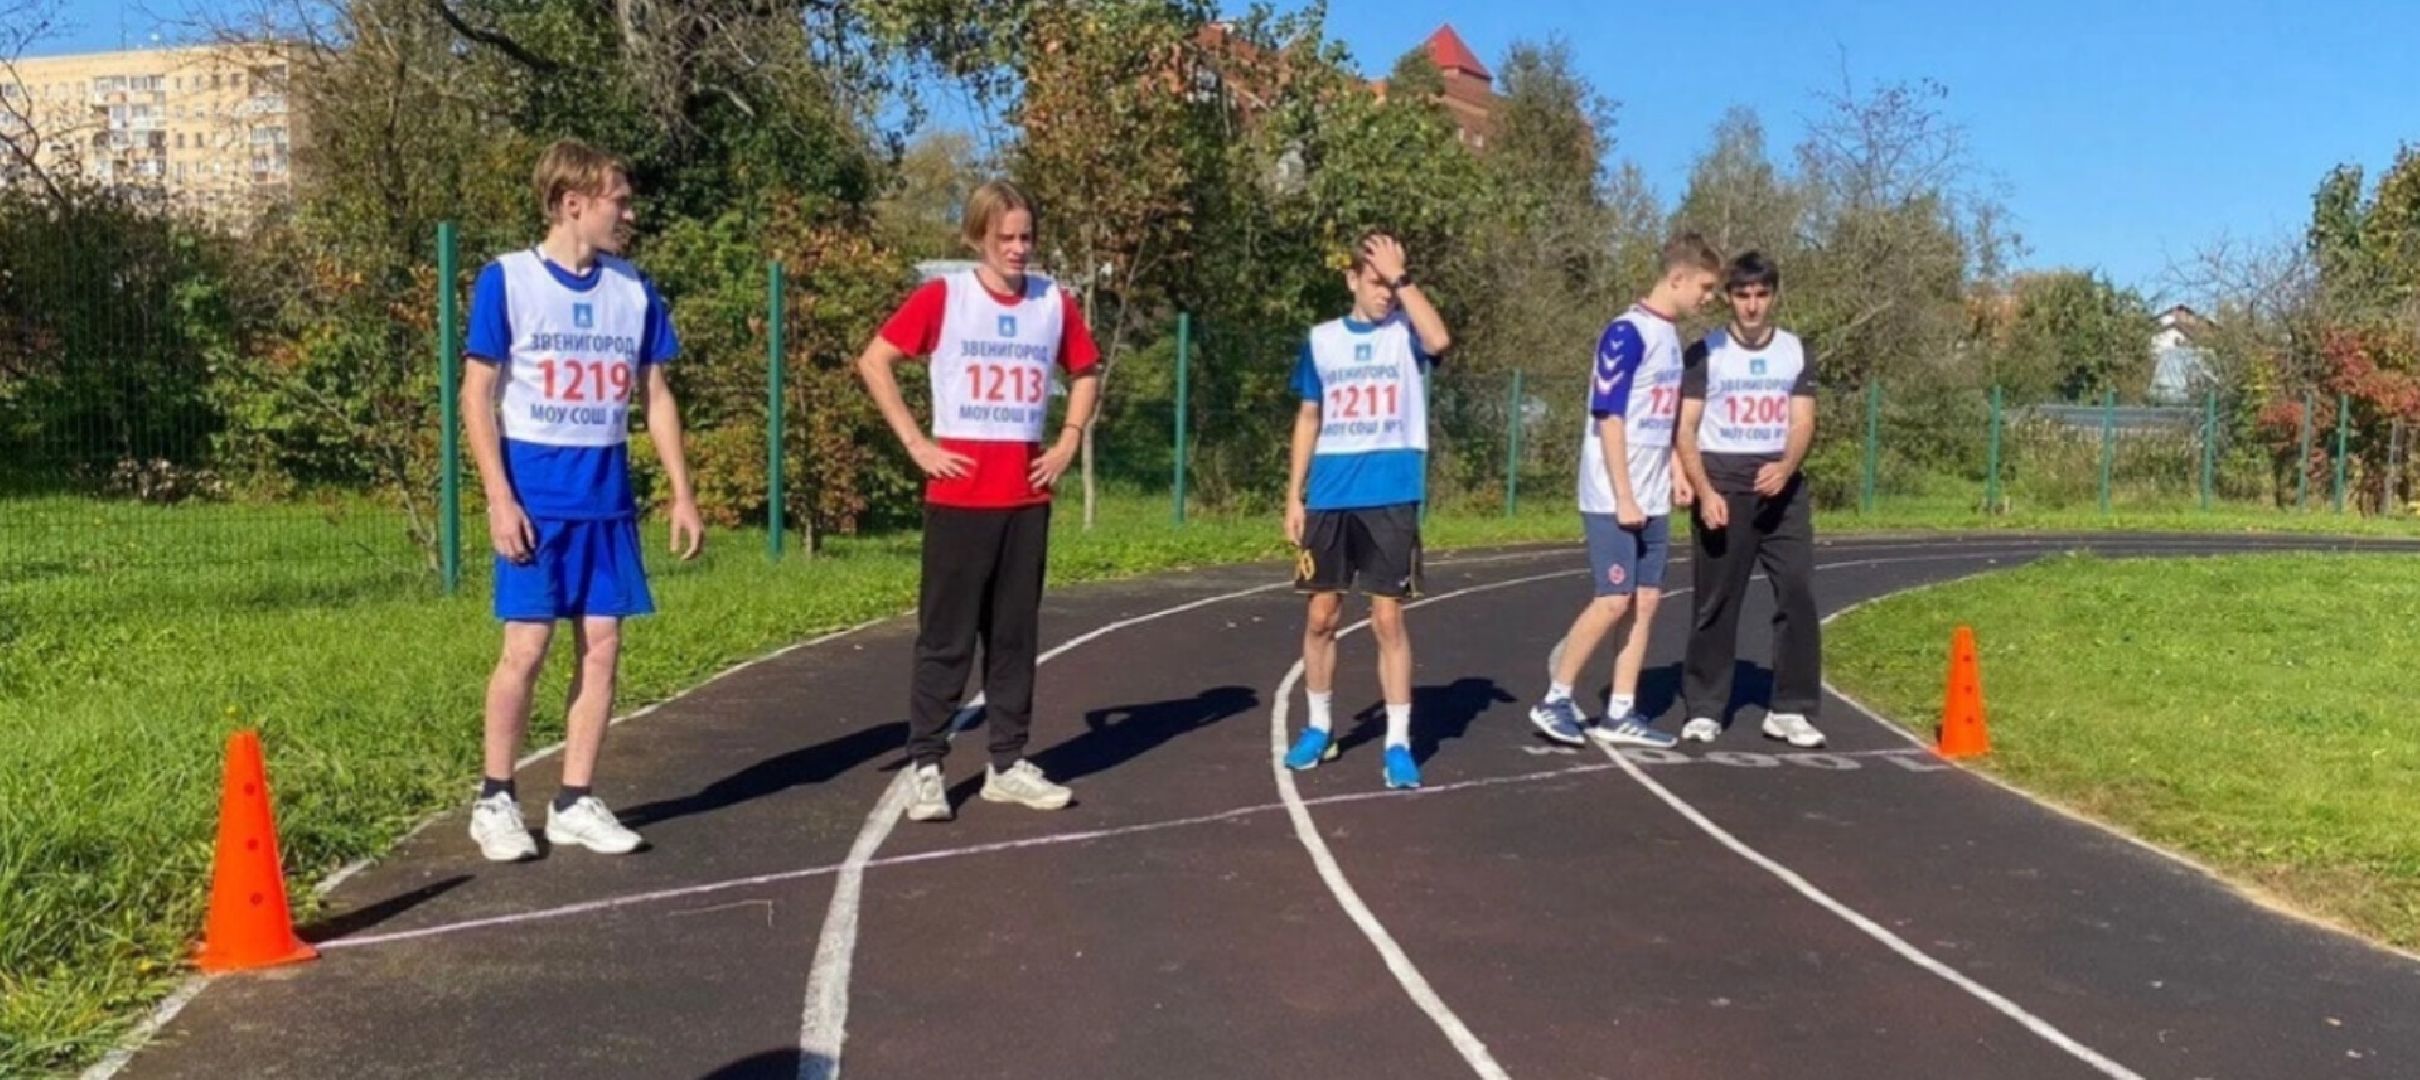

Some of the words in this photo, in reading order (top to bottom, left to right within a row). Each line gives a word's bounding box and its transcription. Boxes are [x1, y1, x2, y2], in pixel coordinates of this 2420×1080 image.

[530, 332, 634, 355] ЗВЕНИГОРОД
[960, 340, 1048, 362] ЗВЕНИГОРОД
[538, 359, 631, 401] 1219
[966, 364, 1043, 404] 1213
[1331, 384, 1397, 418] 1211
[530, 403, 567, 424] МОУ
[571, 407, 606, 425] СОШ
[960, 405, 990, 420] МОУ
[993, 407, 1024, 423] СОШ
